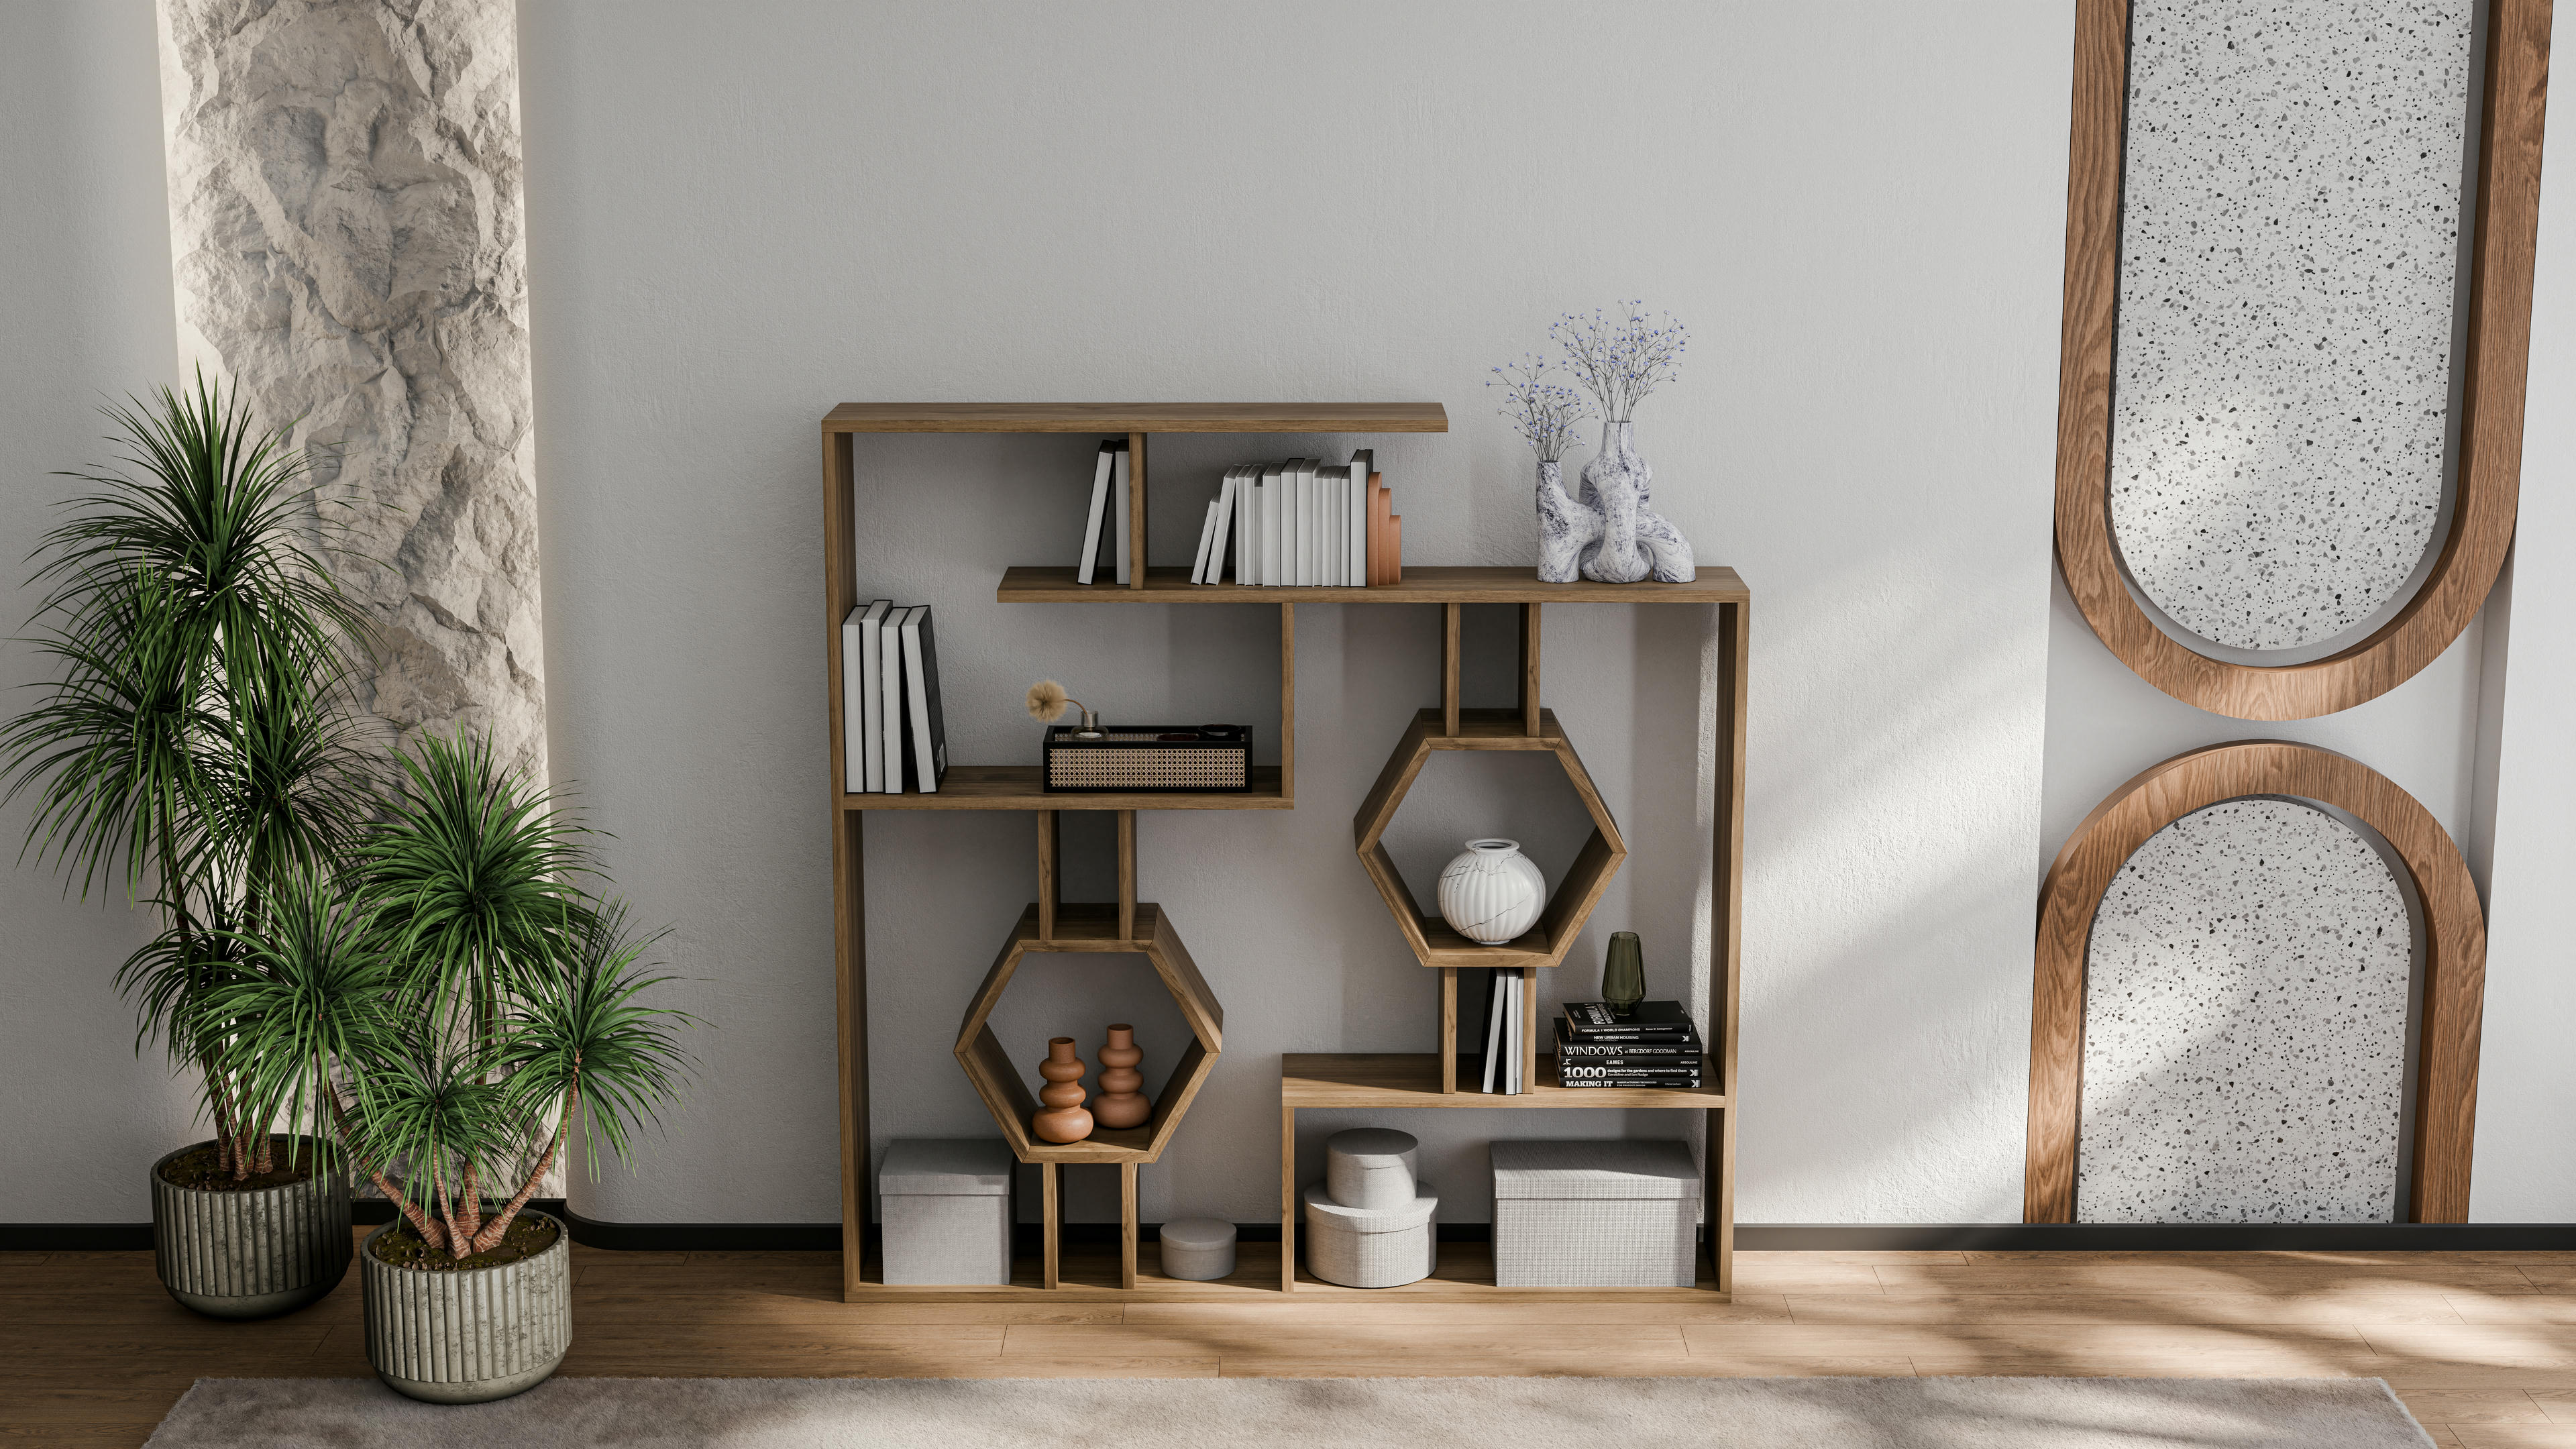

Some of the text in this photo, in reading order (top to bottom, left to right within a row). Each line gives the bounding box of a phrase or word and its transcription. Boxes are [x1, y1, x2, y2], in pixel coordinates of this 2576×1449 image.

[1585, 1006, 1606, 1024] FORMULA
[1564, 1046, 1623, 1056] WINDOWS
[1564, 1067, 1607, 1078] 1000
